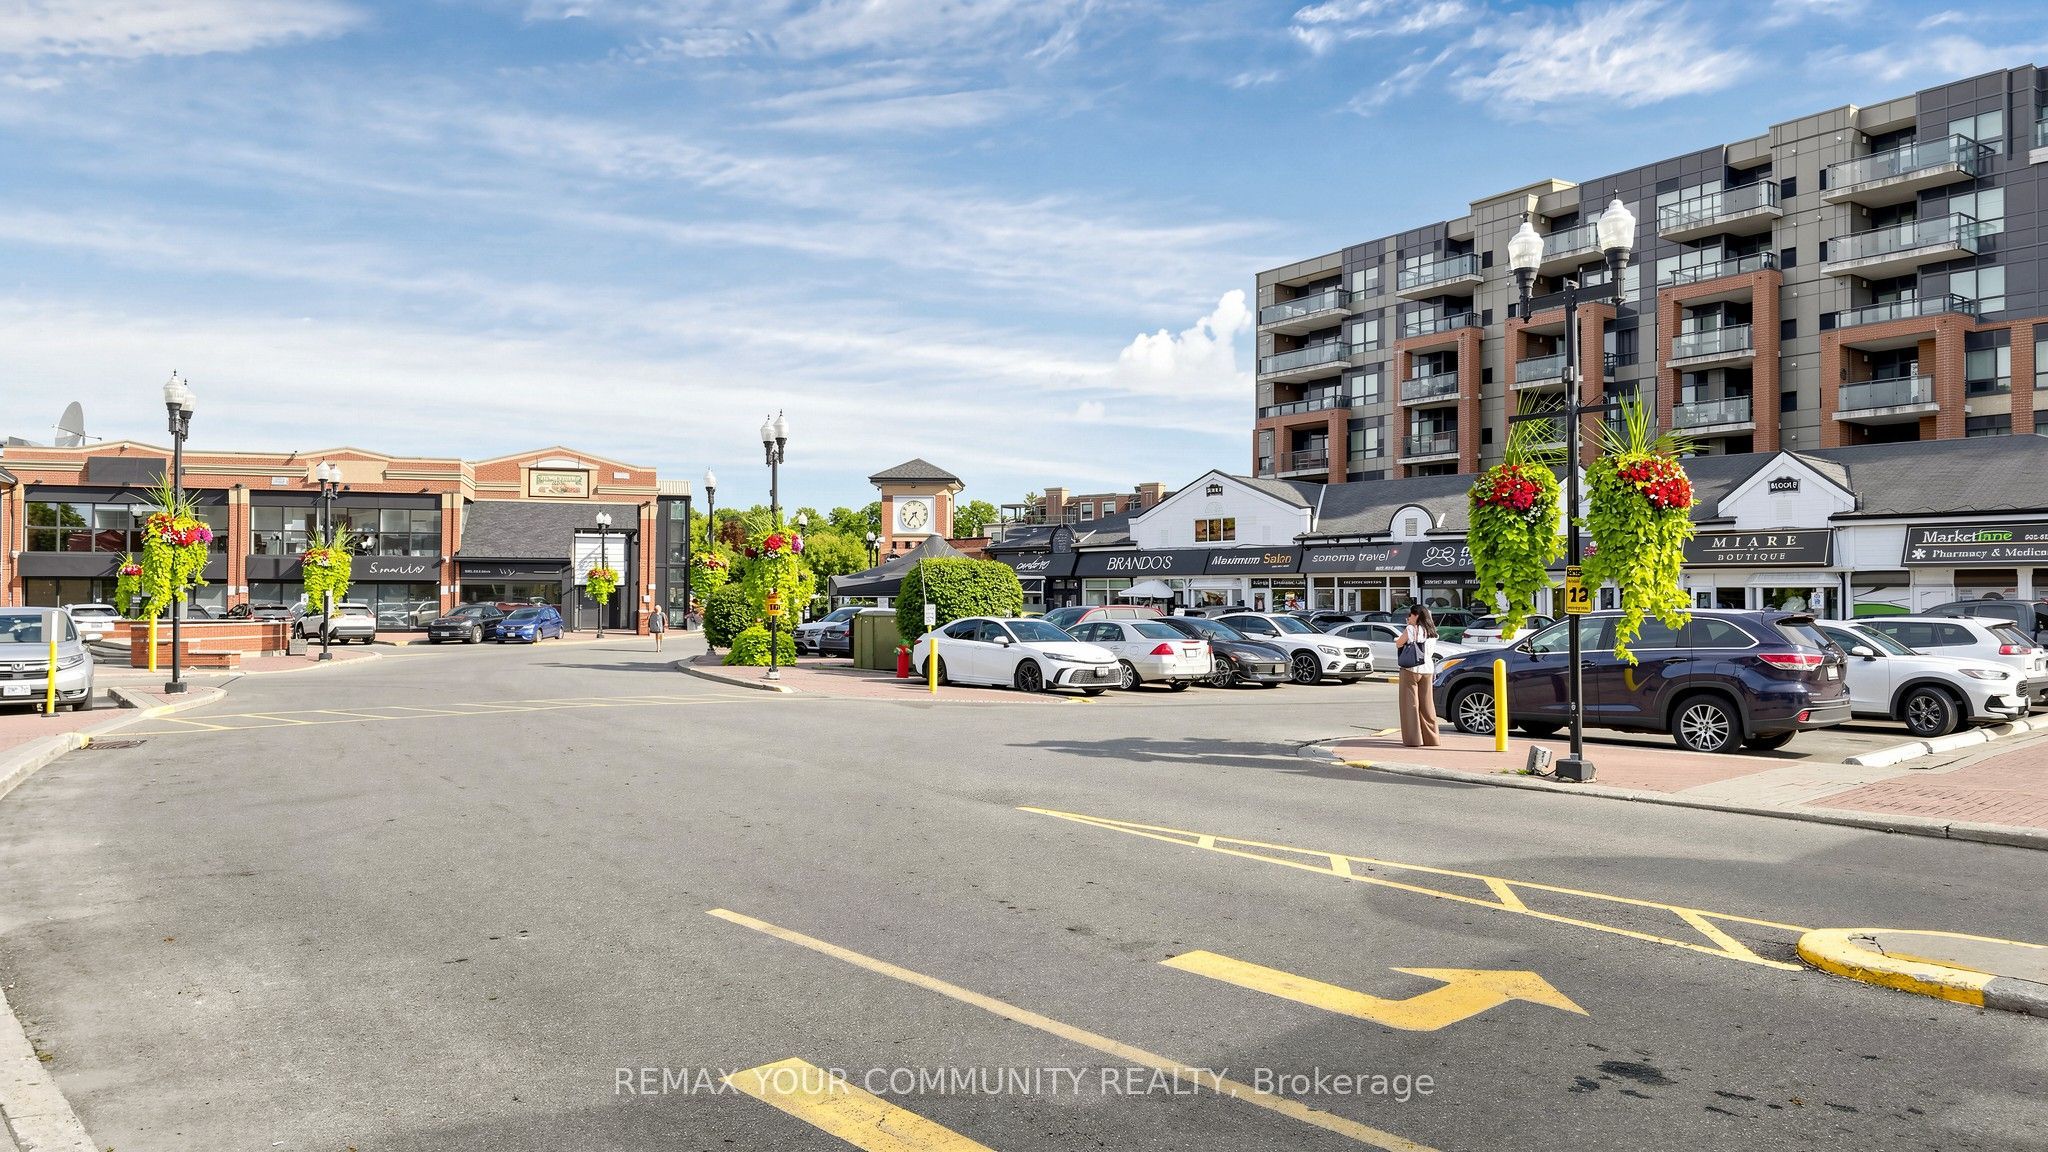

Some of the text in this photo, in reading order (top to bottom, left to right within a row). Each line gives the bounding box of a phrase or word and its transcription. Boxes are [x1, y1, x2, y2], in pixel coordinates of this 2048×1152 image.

[1712, 535, 1798, 548] MIARE
[1263, 552, 1292, 565] Salon
[1311, 549, 1391, 563] sonoma travel
[1717, 553, 1786, 561] BOUTIQUE
[1932, 548, 1988, 559] Pharmacy
[1991, 548, 2001, 557] &
[1106, 555, 1173, 571] BRANDO'S
[1568, 586, 1590, 603] 12
